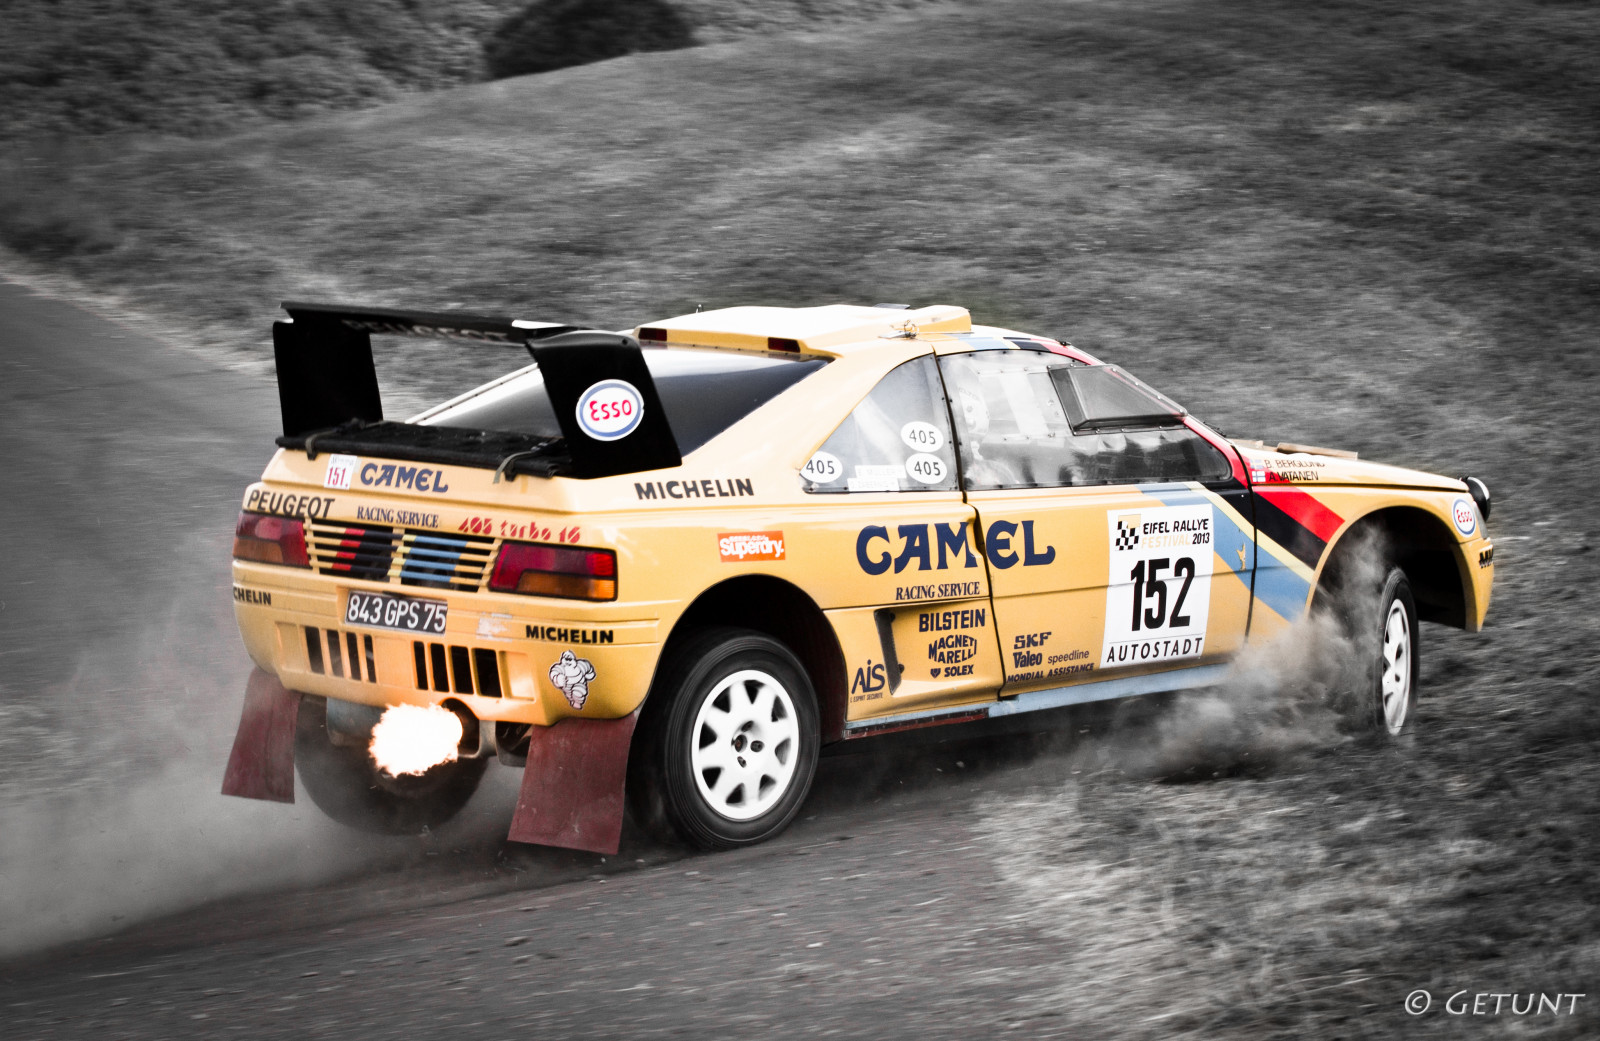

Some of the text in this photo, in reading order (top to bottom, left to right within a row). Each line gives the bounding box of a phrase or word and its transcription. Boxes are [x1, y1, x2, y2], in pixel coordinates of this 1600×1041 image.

[908, 429, 936, 445] 405
[806, 459, 835, 476] 405
[914, 460, 941, 477] 405
[360, 463, 448, 493] CAMEL
[634, 478, 754, 500] MICHELIN
[247, 489, 335, 518] PEUGEOT
[356, 506, 439, 528] RACING SERVICE
[1142, 518, 1209, 535] EIFEL RALLYE
[458, 516, 581, 544] 405 turbo 16
[856, 519, 1056, 576] CAMEL
[1141, 532, 1210, 549] FESTIVAL 2013
[895, 581, 980, 601] RACING SERVICE
[1130, 557, 1195, 631] 152
[347, 595, 448, 632] 843 GPS 75
[918, 608, 985, 632] BILSTEIN
[525, 624, 614, 644] MICHELIN
[1013, 631, 1052, 649] SKF
[1013, 649, 1090, 669] Valeo speedline
[1106, 637, 1203, 663] AUTOSTADT
[944, 664, 974, 677] SOLEX
[1006, 662, 1095, 682] MONDIAL ASSISTANCE
